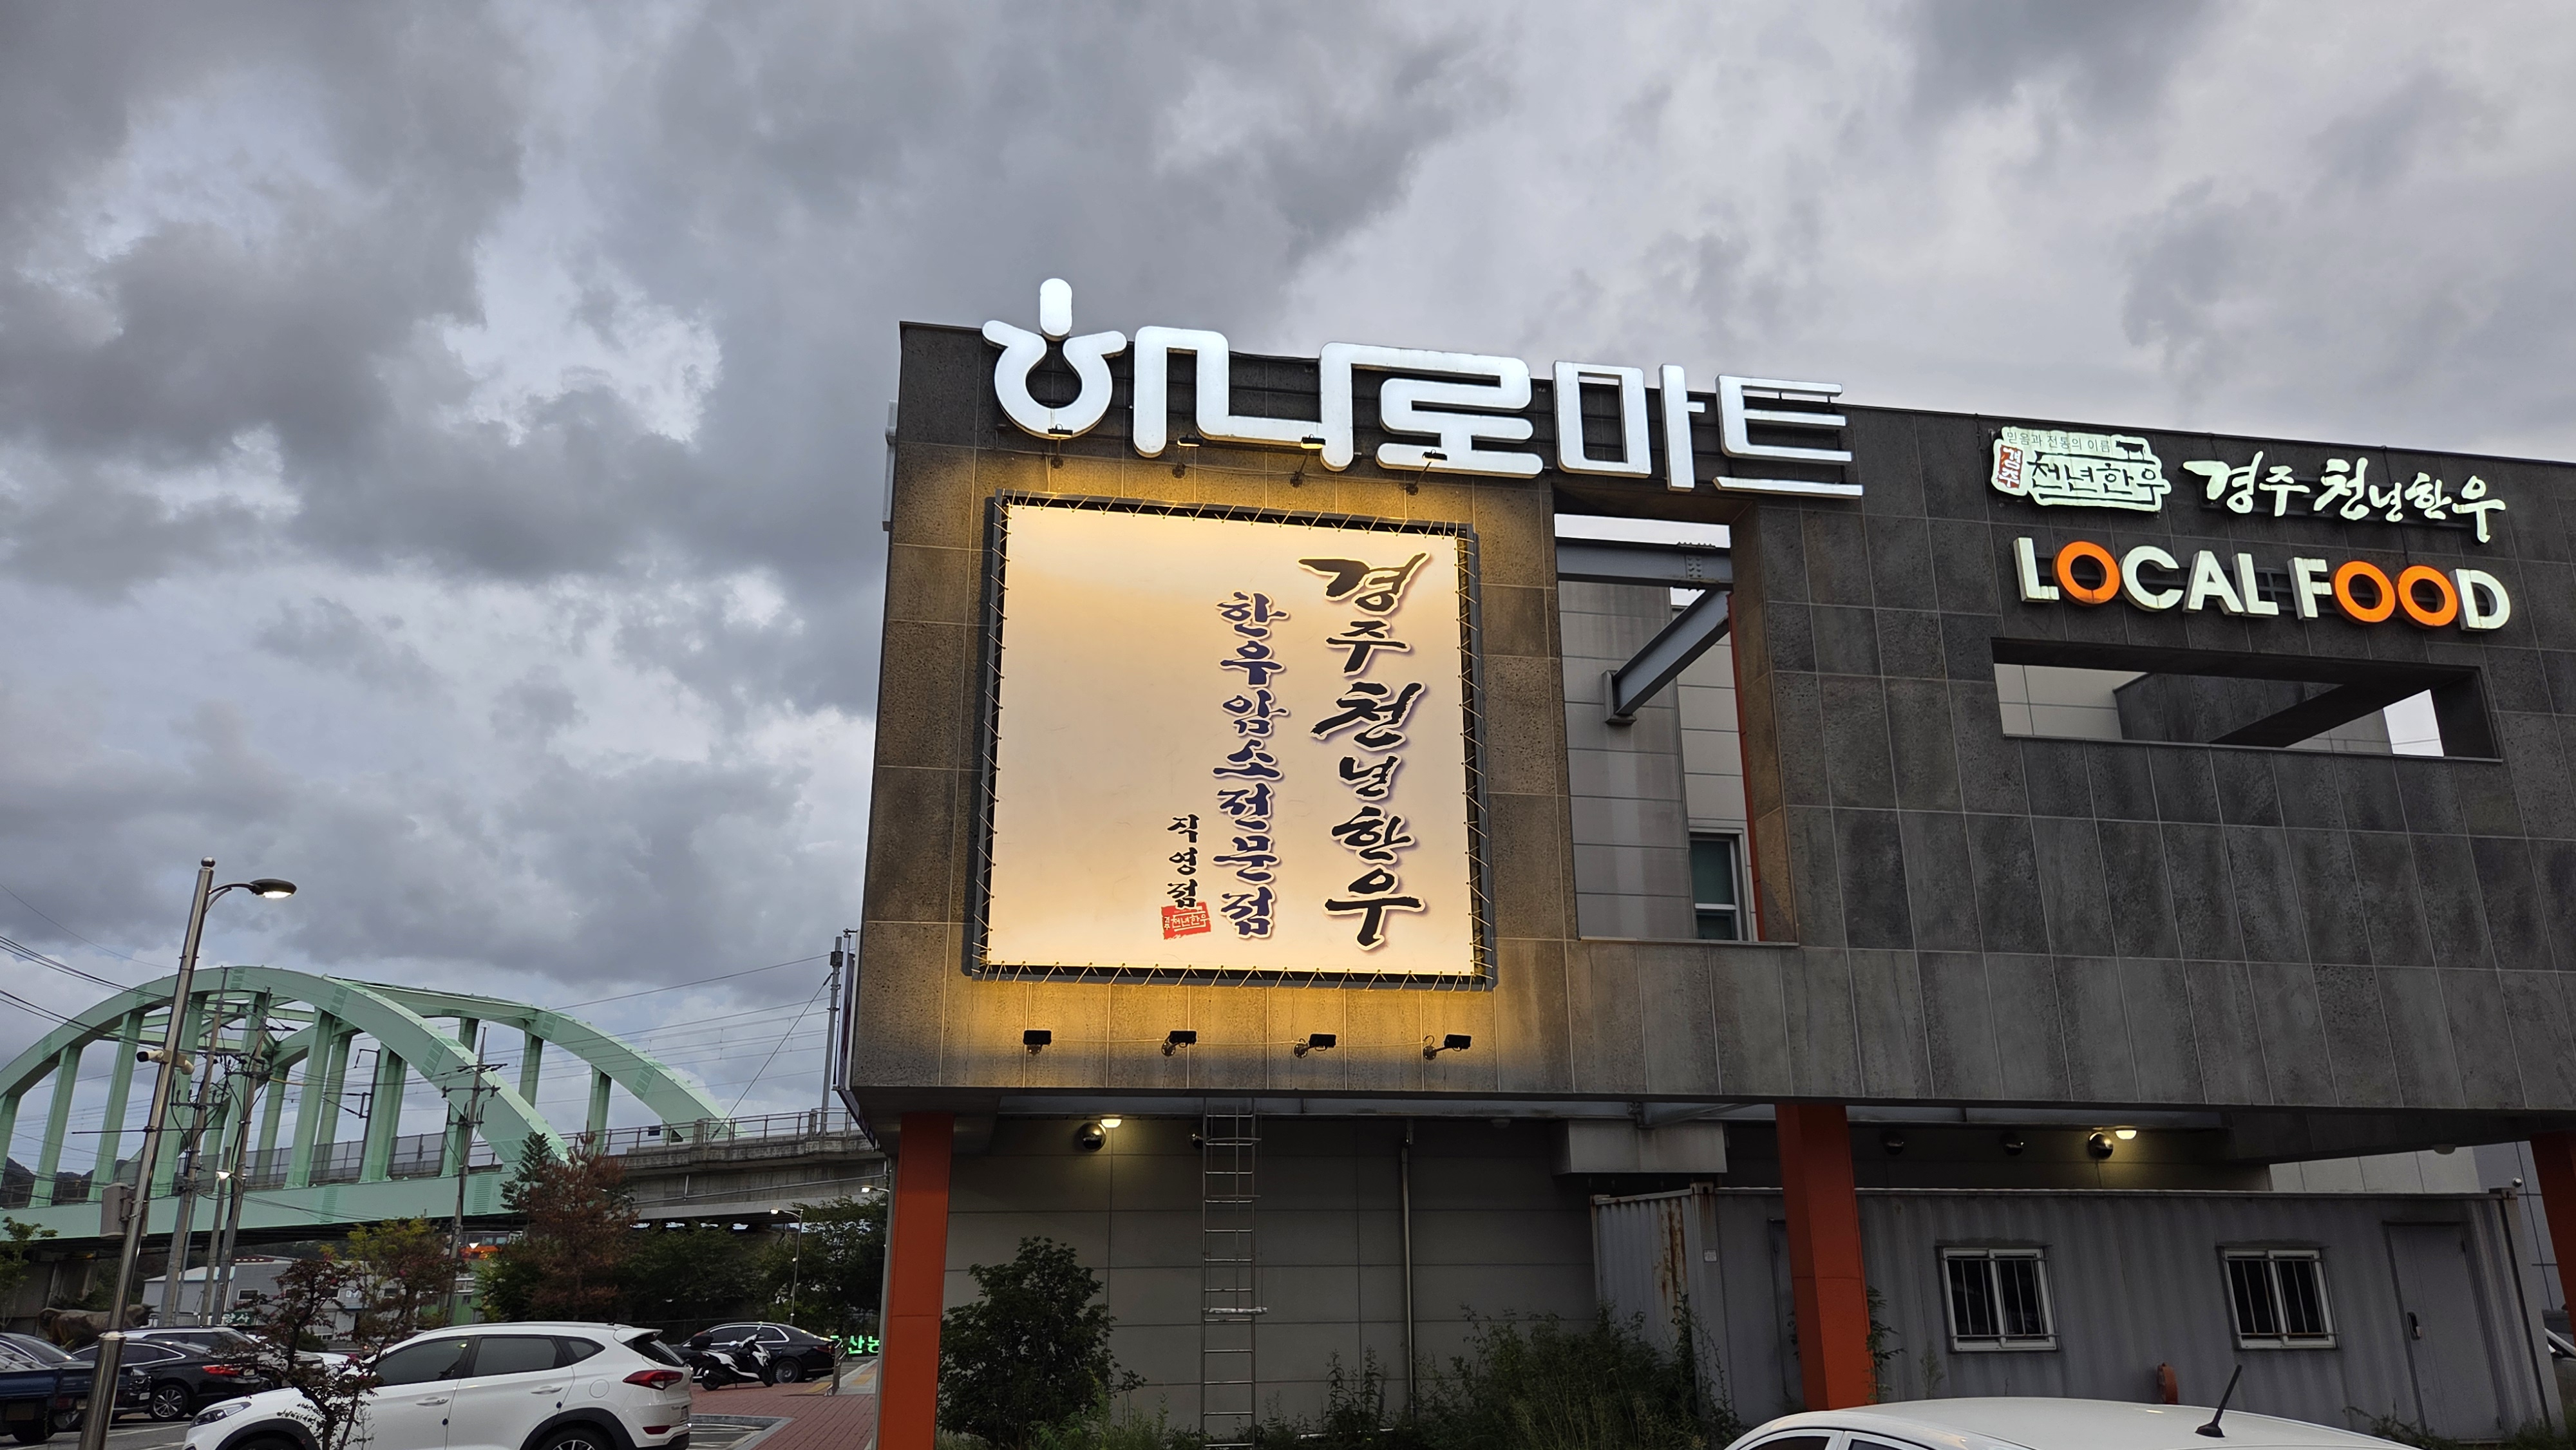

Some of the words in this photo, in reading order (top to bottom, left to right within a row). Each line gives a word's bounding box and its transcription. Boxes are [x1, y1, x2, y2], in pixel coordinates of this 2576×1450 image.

[982, 278, 1863, 497] 하나로마트
[1998, 446, 2022, 487] 경주
[2007, 431, 2043, 447] 믿음과
[2087, 439, 2110, 453] 이름
[2027, 450, 2166, 504] 천년한우
[2013, 537, 2280, 619] LOCAL
[2287, 556, 2512, 632] FOOD
[1212, 592, 1288, 937] 한우암소전문점
[1166, 814, 1200, 908] 직영점
